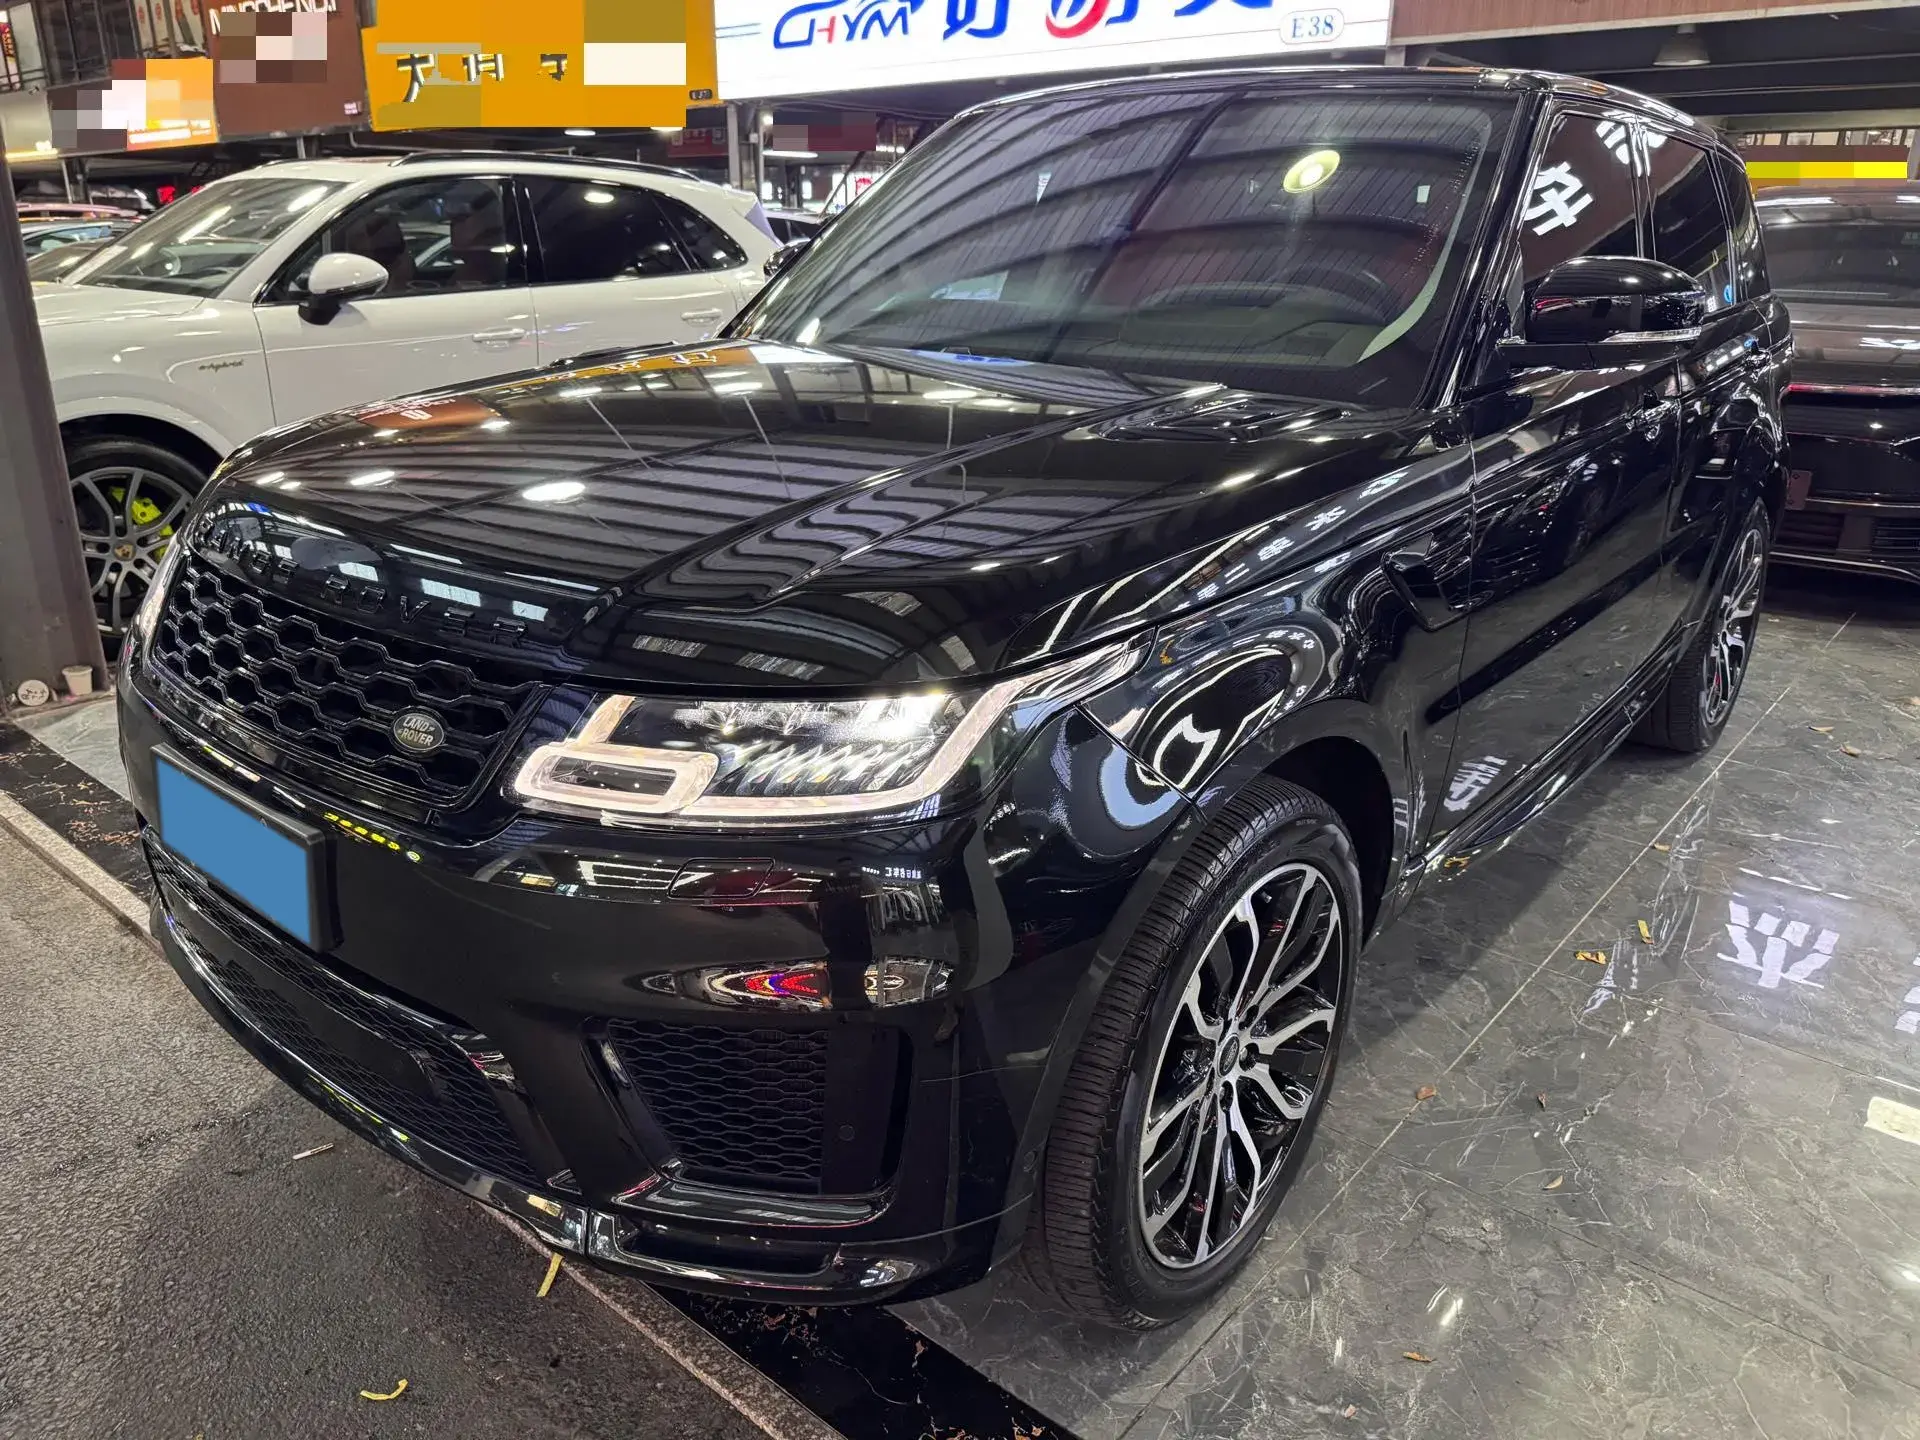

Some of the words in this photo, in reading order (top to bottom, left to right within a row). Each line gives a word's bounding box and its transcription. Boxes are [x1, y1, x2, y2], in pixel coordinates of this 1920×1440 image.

[1291, 14, 1335, 39] E38
[320, 574, 529, 649] ROVER
[403, 716, 430, 732] LAND
[401, 727, 434, 746] ROVER
